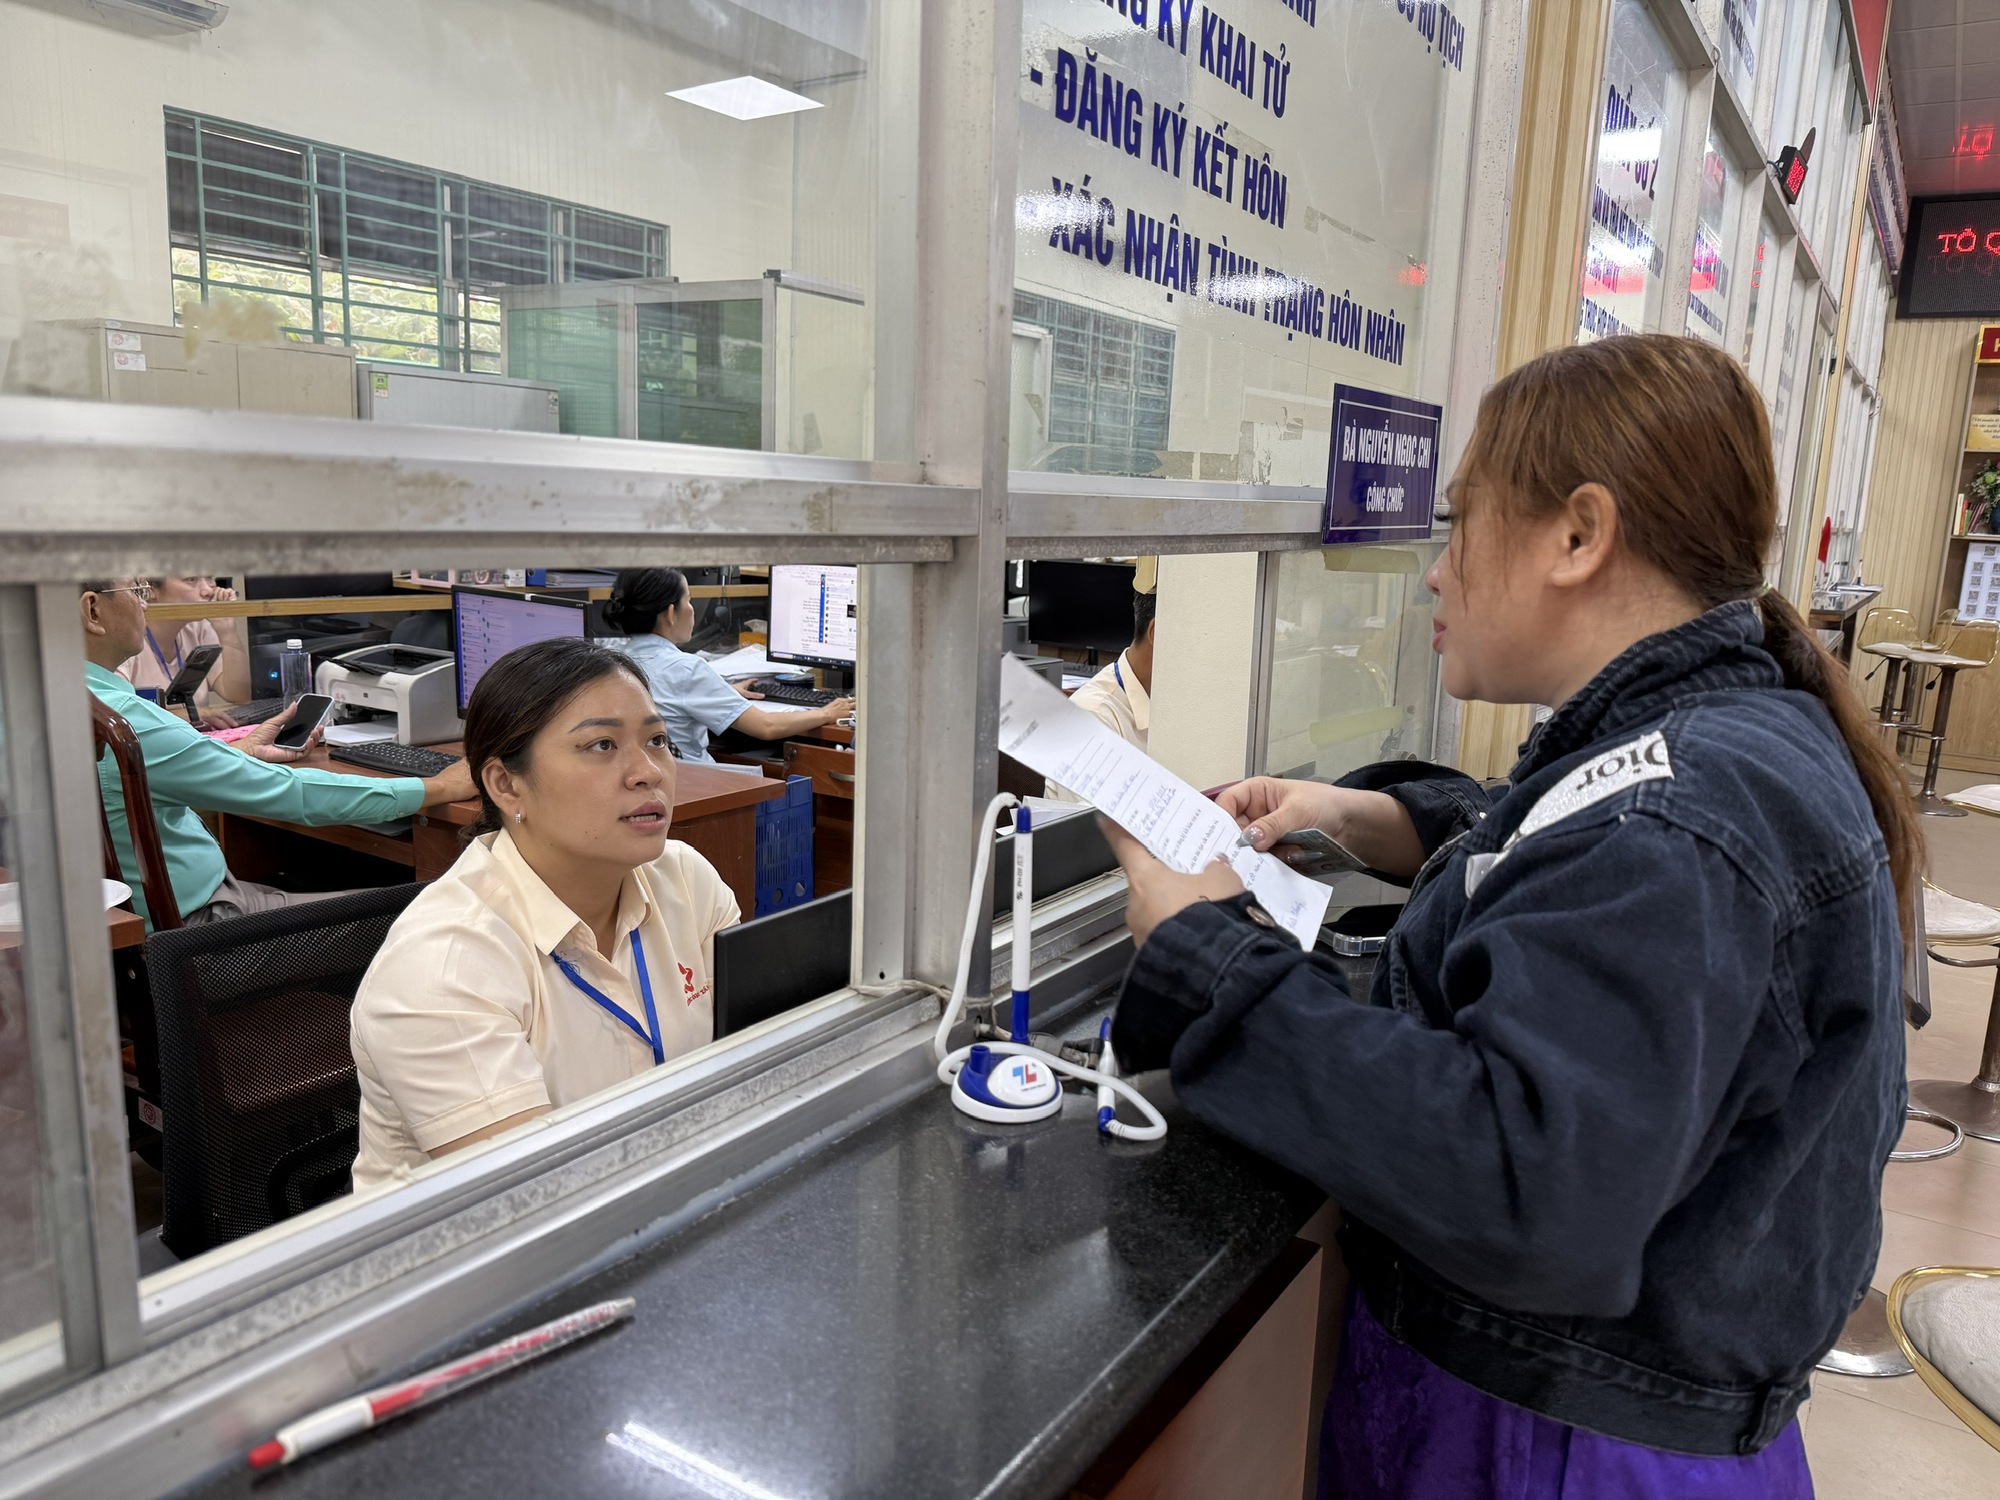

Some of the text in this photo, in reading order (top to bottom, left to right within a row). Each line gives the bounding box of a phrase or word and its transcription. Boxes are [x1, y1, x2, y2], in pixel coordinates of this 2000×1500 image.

[1200, 5, 1257, 100] KHAI
[1262, 42, 1291, 119] TỬ
[1438, 3, 1466, 73] TỊCH
[1055, 46, 1143, 159] ĐĂNG
[1151, 101, 1188, 179] KÝ
[1193, 120, 1239, 204] KẾT
[1242, 152, 1288, 230] HÔN
[1123, 207, 1201, 303] NHẬN
[1327, 289, 1363, 352] HÔN
[1364, 308, 1406, 366] NHÂN
[1342, 419, 1432, 474] BÀ NGUYỄN NGỌC CHI
[1366, 481, 1386, 512] CÔNG
